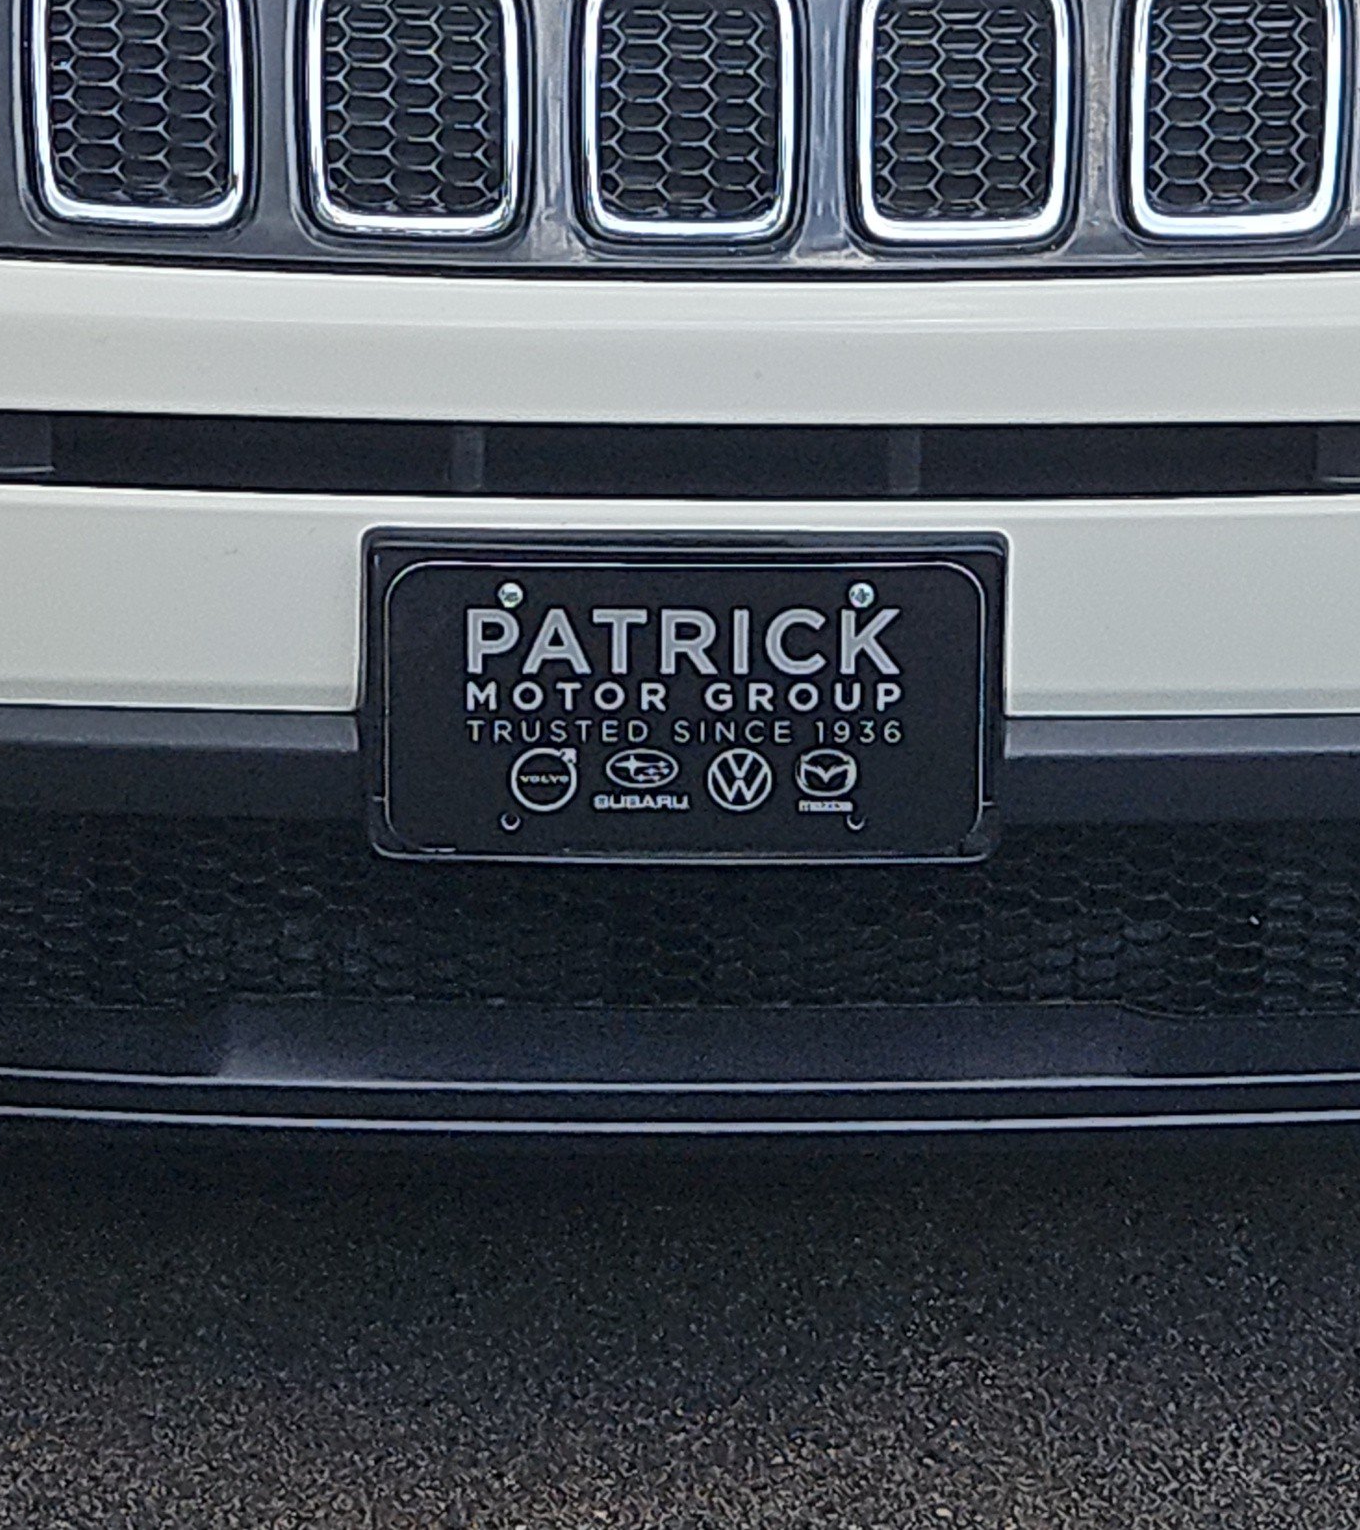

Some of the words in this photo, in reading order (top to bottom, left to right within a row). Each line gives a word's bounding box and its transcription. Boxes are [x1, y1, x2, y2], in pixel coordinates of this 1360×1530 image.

[466, 607, 901, 676] PATRICK
[466, 681, 667, 712] MOTOR
[704, 681, 902, 712] GROUP
[466, 719, 649, 744] TRUSTED
[673, 719, 793, 744] SINCE
[815, 719, 903, 744] 1936
[519, 774, 570, 785] VOLVO
[593, 793, 690, 810] SUBARU
